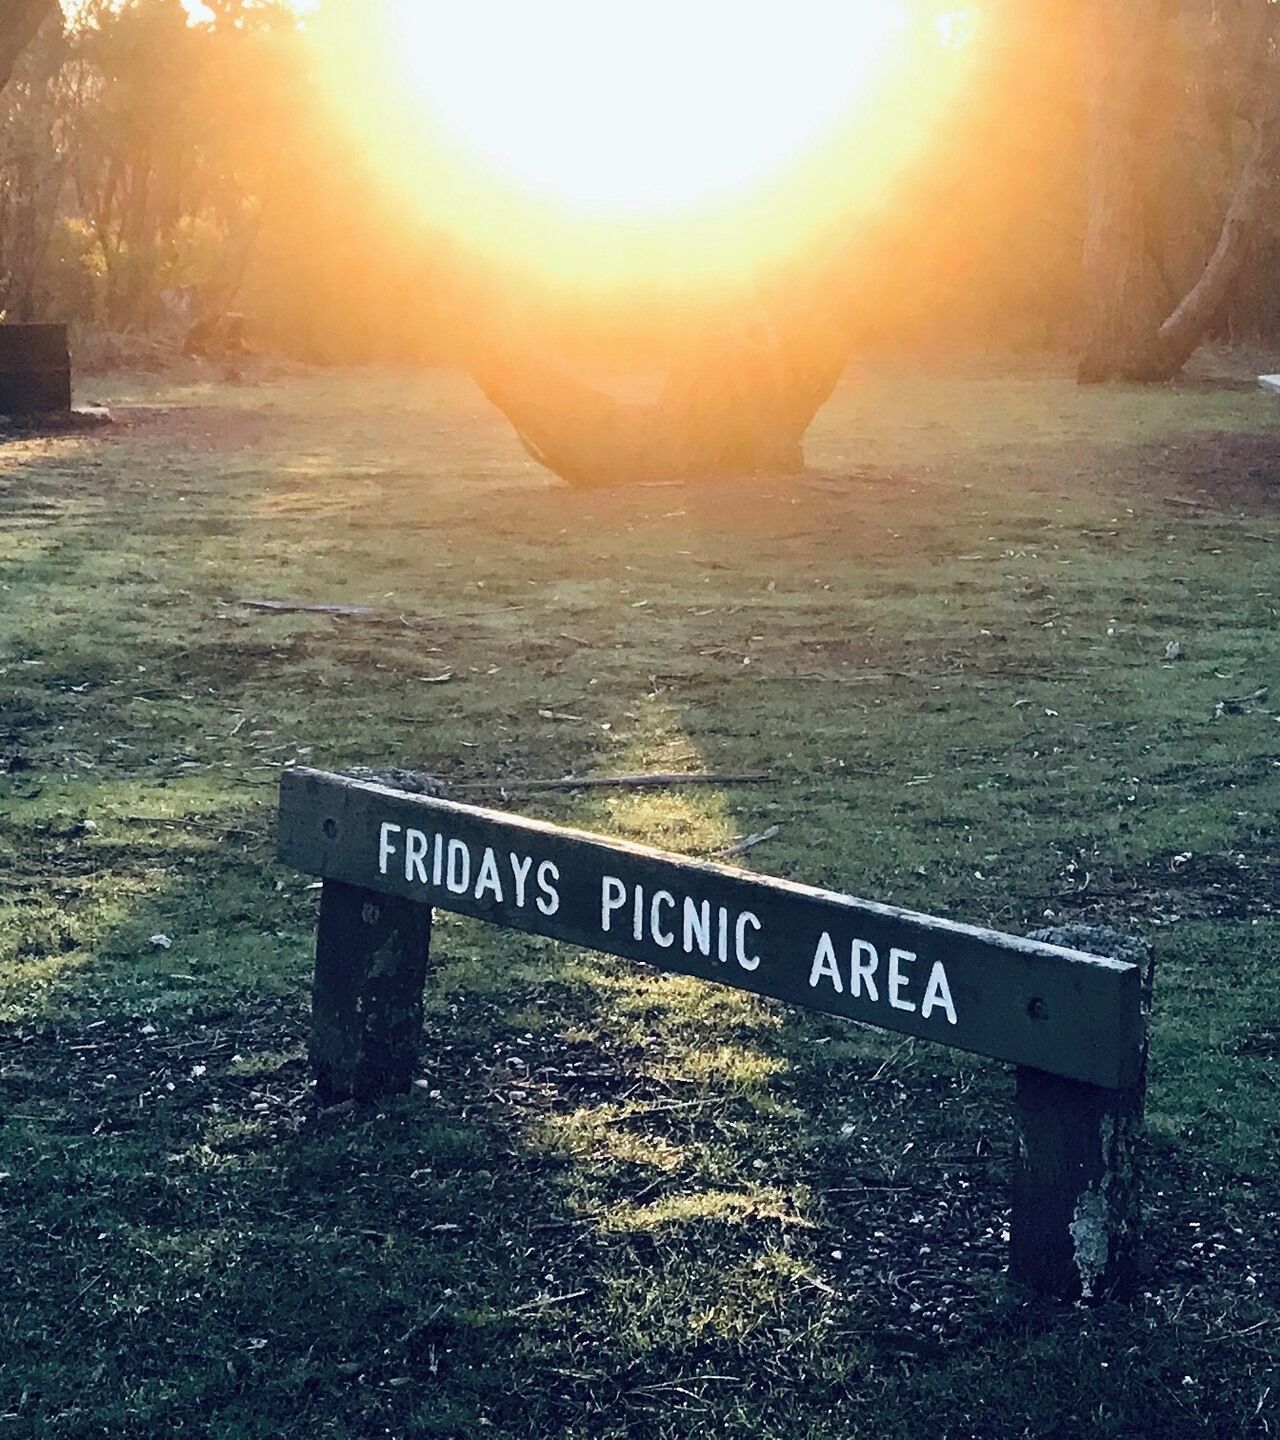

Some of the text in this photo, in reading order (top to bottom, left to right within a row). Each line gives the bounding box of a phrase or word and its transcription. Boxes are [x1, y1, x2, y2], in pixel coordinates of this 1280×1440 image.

[377, 820, 959, 1026] FRIDAYS PICNIC AREA
